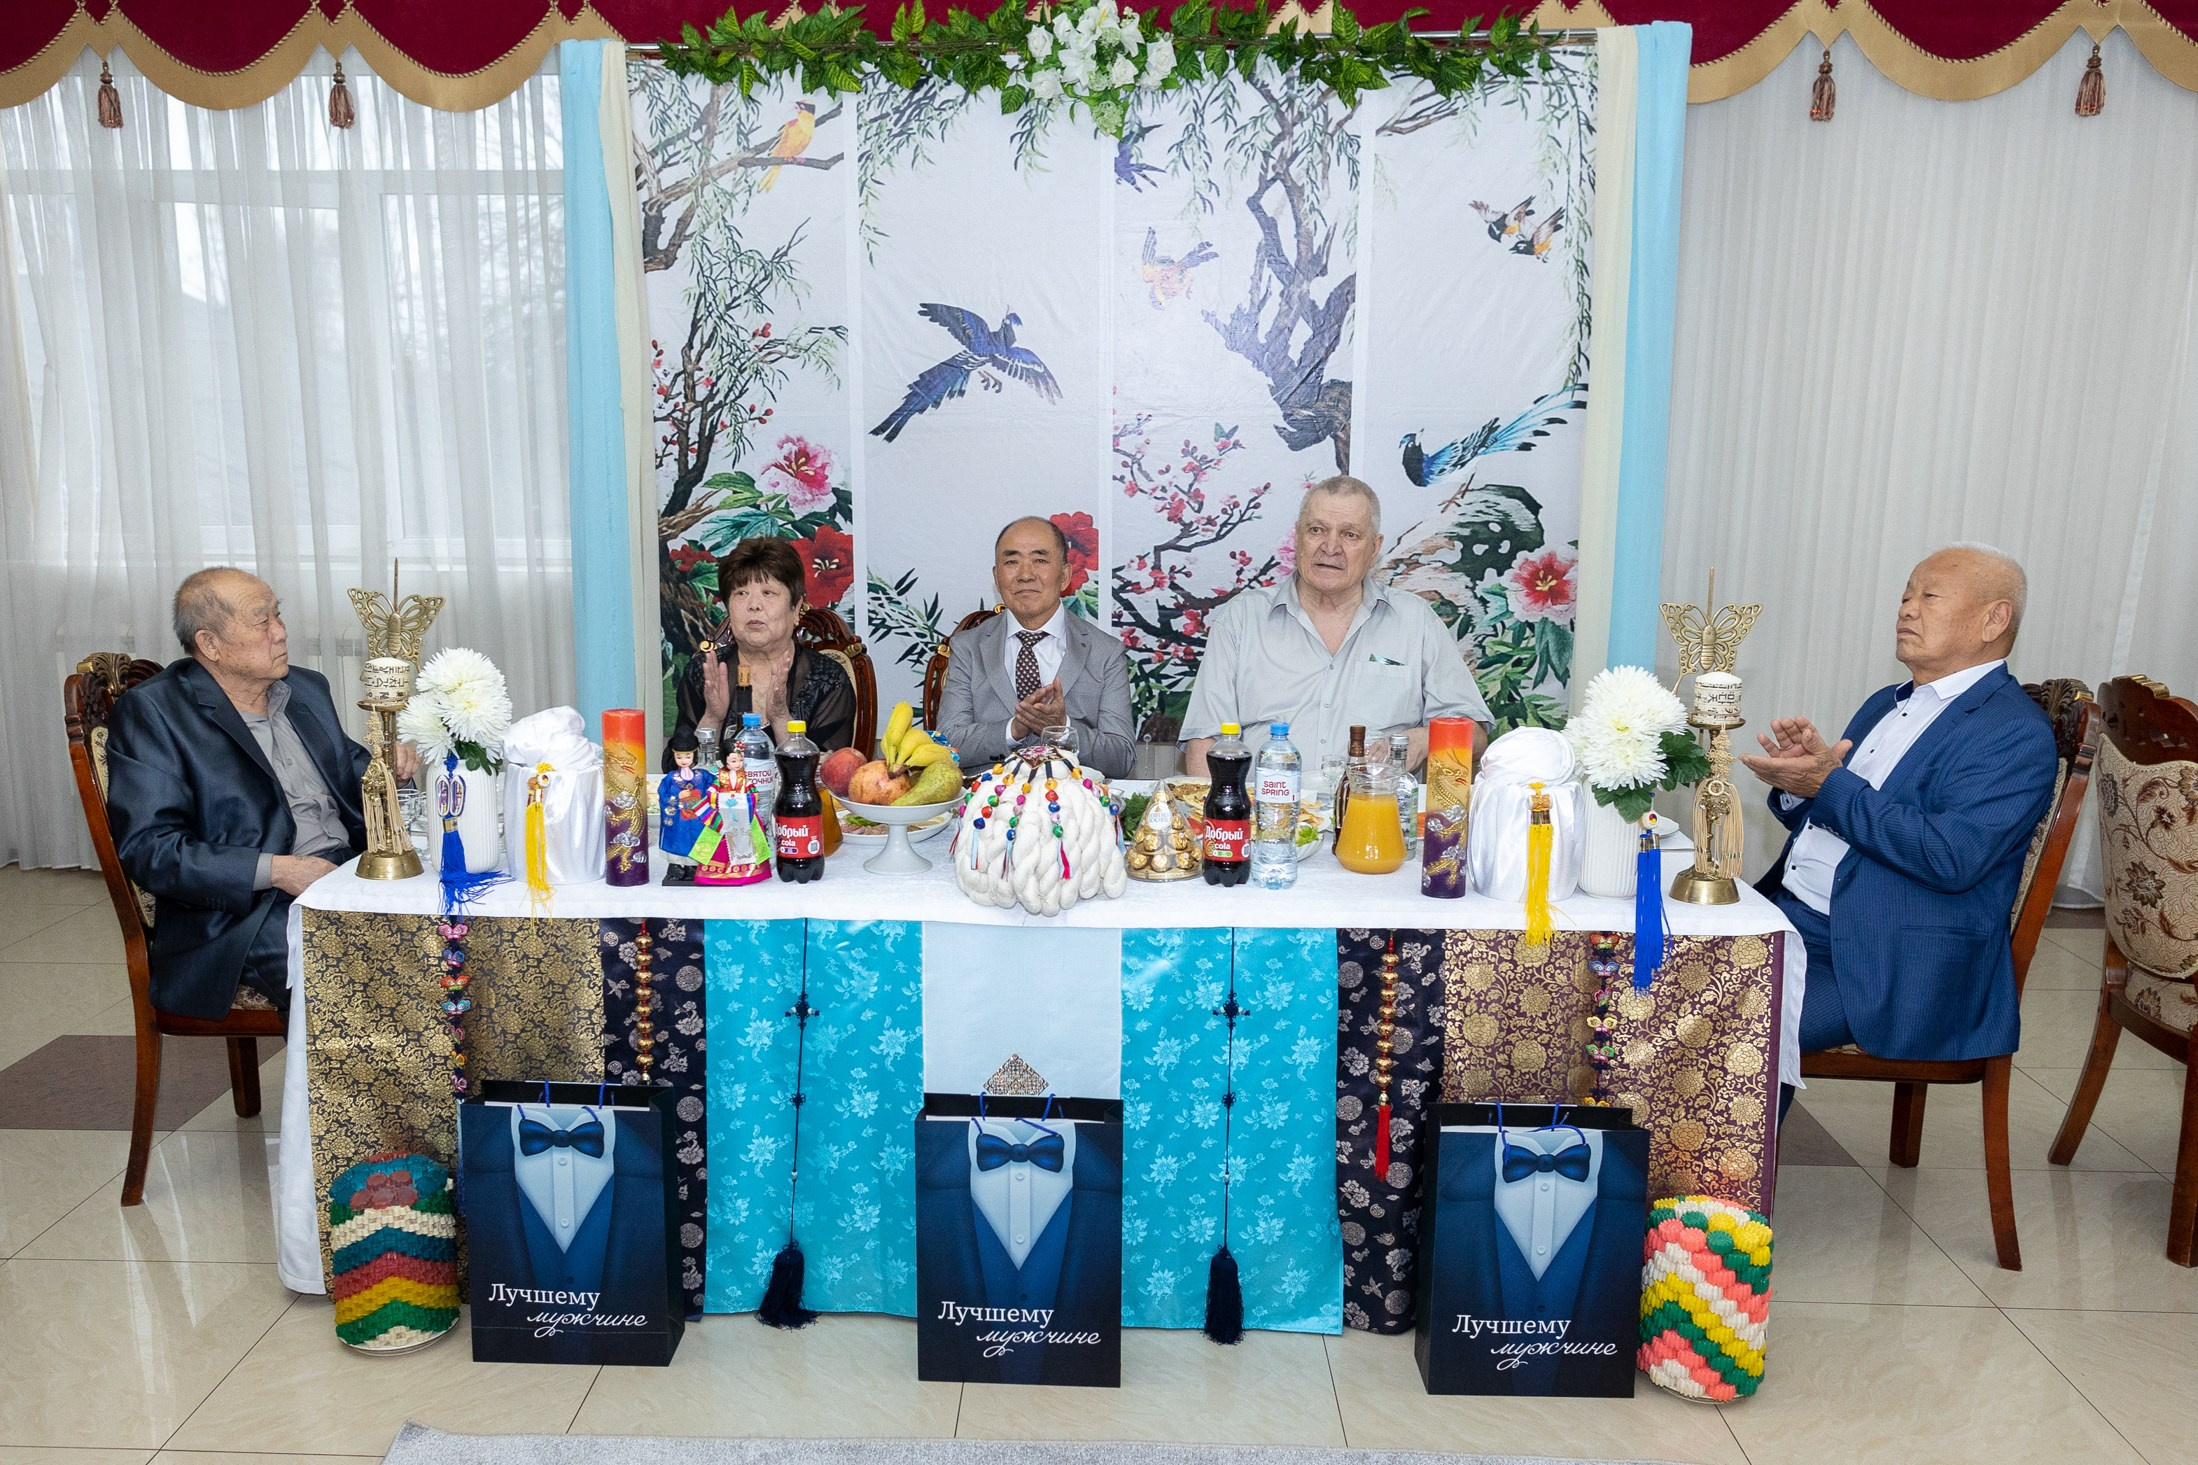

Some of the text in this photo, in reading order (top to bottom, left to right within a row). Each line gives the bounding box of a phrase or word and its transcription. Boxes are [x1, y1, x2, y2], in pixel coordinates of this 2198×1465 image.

[1261, 788, 1290, 797] SPRING
[1204, 825, 1244, 842] Добрый
[488, 1283, 601, 1311] Лучшему
[526, 1311, 649, 1339] мужчине
[937, 1301, 1055, 1329] Лучшему
[1451, 1314, 1572, 1340] Лучшему
[975, 1330, 1102, 1358] мужчине
[1490, 1341, 1618, 1371] мужчине
